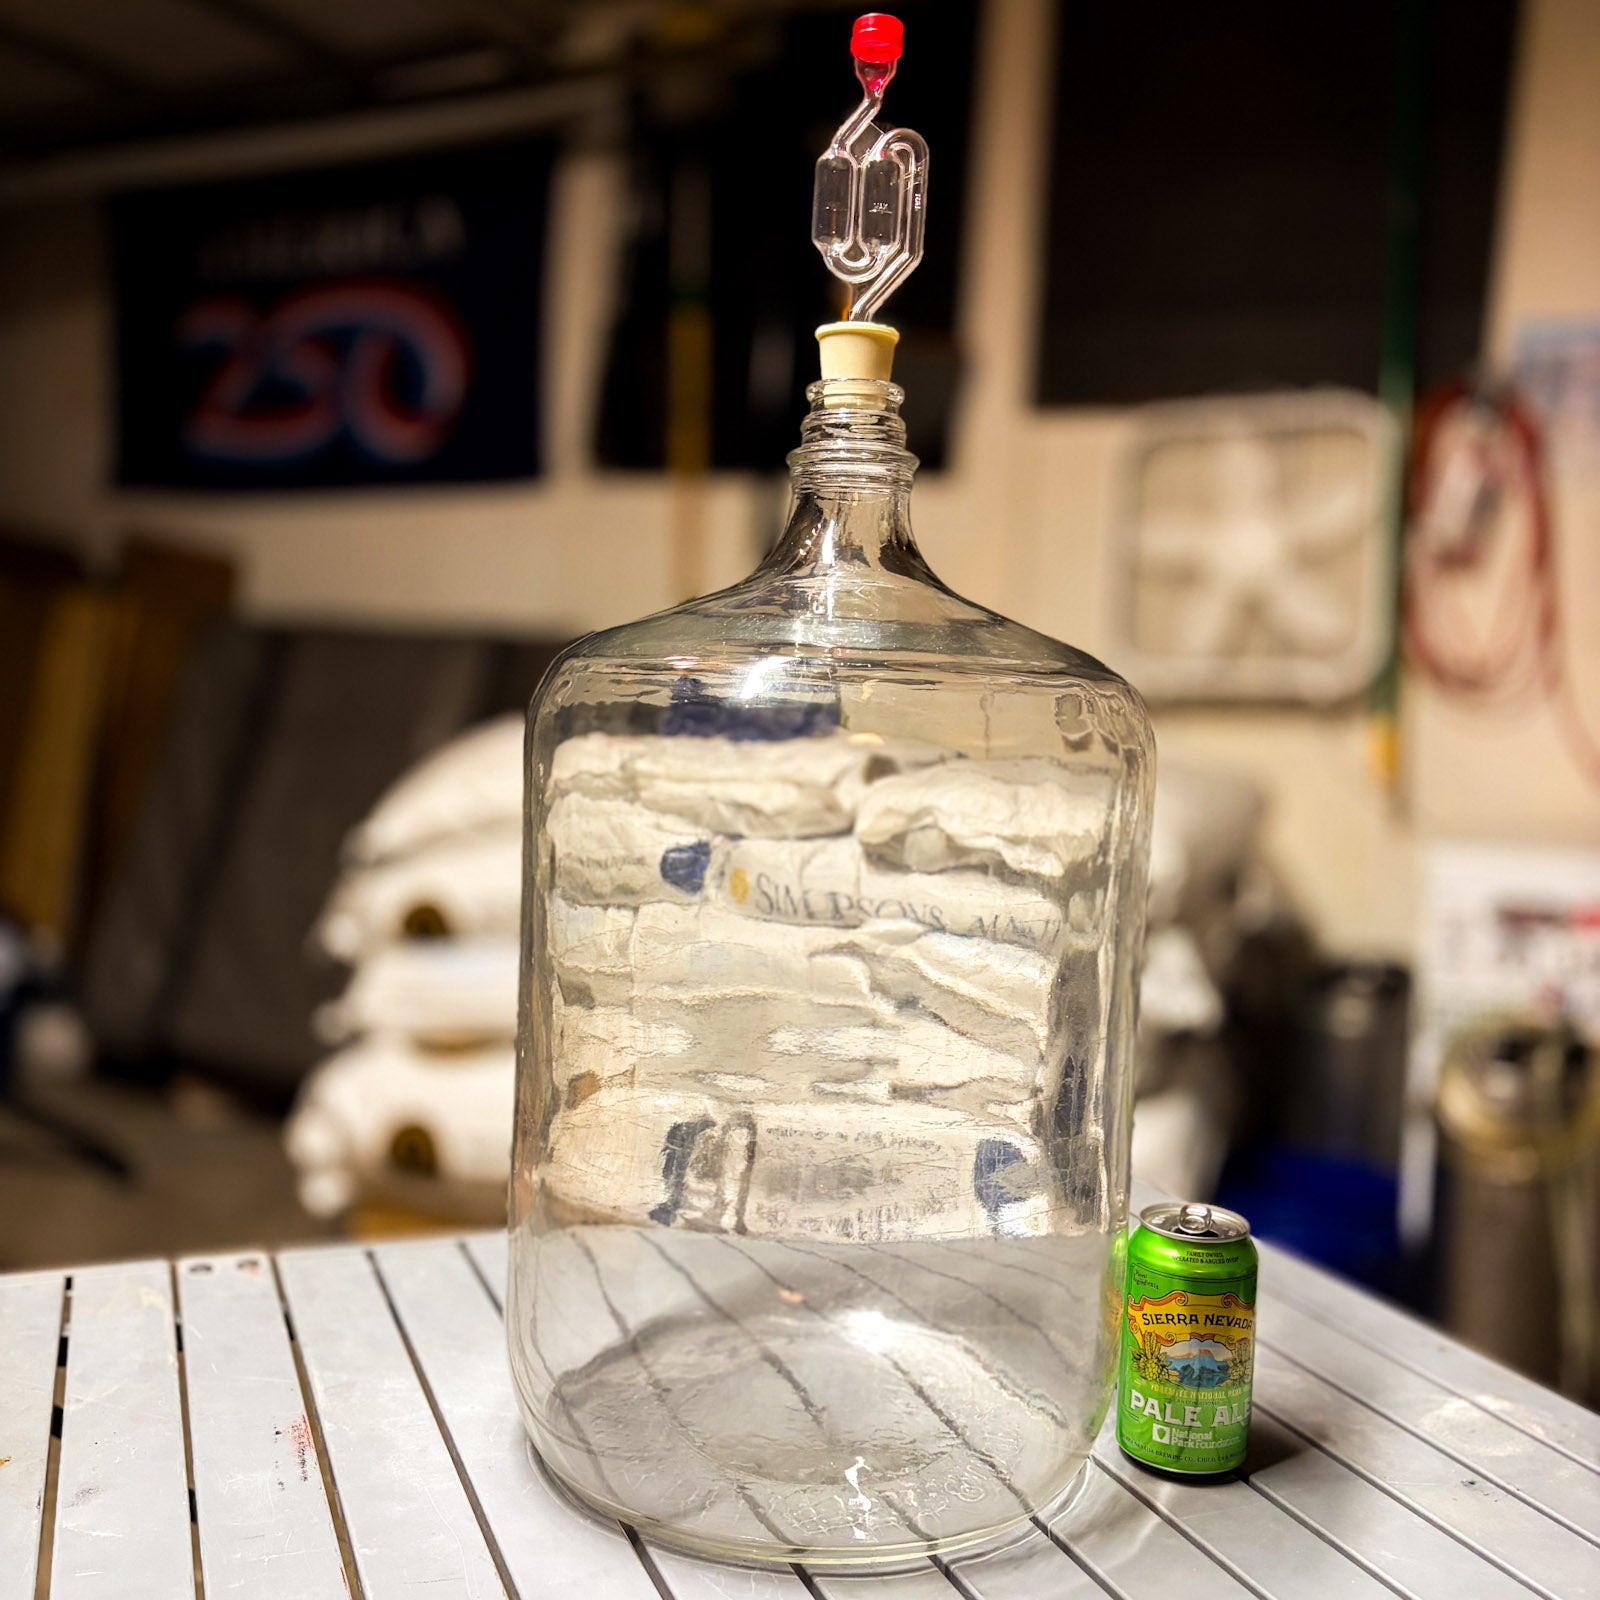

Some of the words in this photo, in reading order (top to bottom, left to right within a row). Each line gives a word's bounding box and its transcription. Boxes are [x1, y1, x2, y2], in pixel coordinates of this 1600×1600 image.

[1186, 1250, 1205, 1258] FAMILY
[1141, 1313, 1200, 1327] SIERRA
[1203, 1313, 1253, 1331] NEVADA
[1190, 1389, 1226, 1400] NATIONAL
[1130, 1389, 1202, 1428] PALE
[1171, 1427, 1213, 1441] National
[1171, 1437, 1195, 1449] Park
[1155, 1449, 1182, 1461] BREWING
